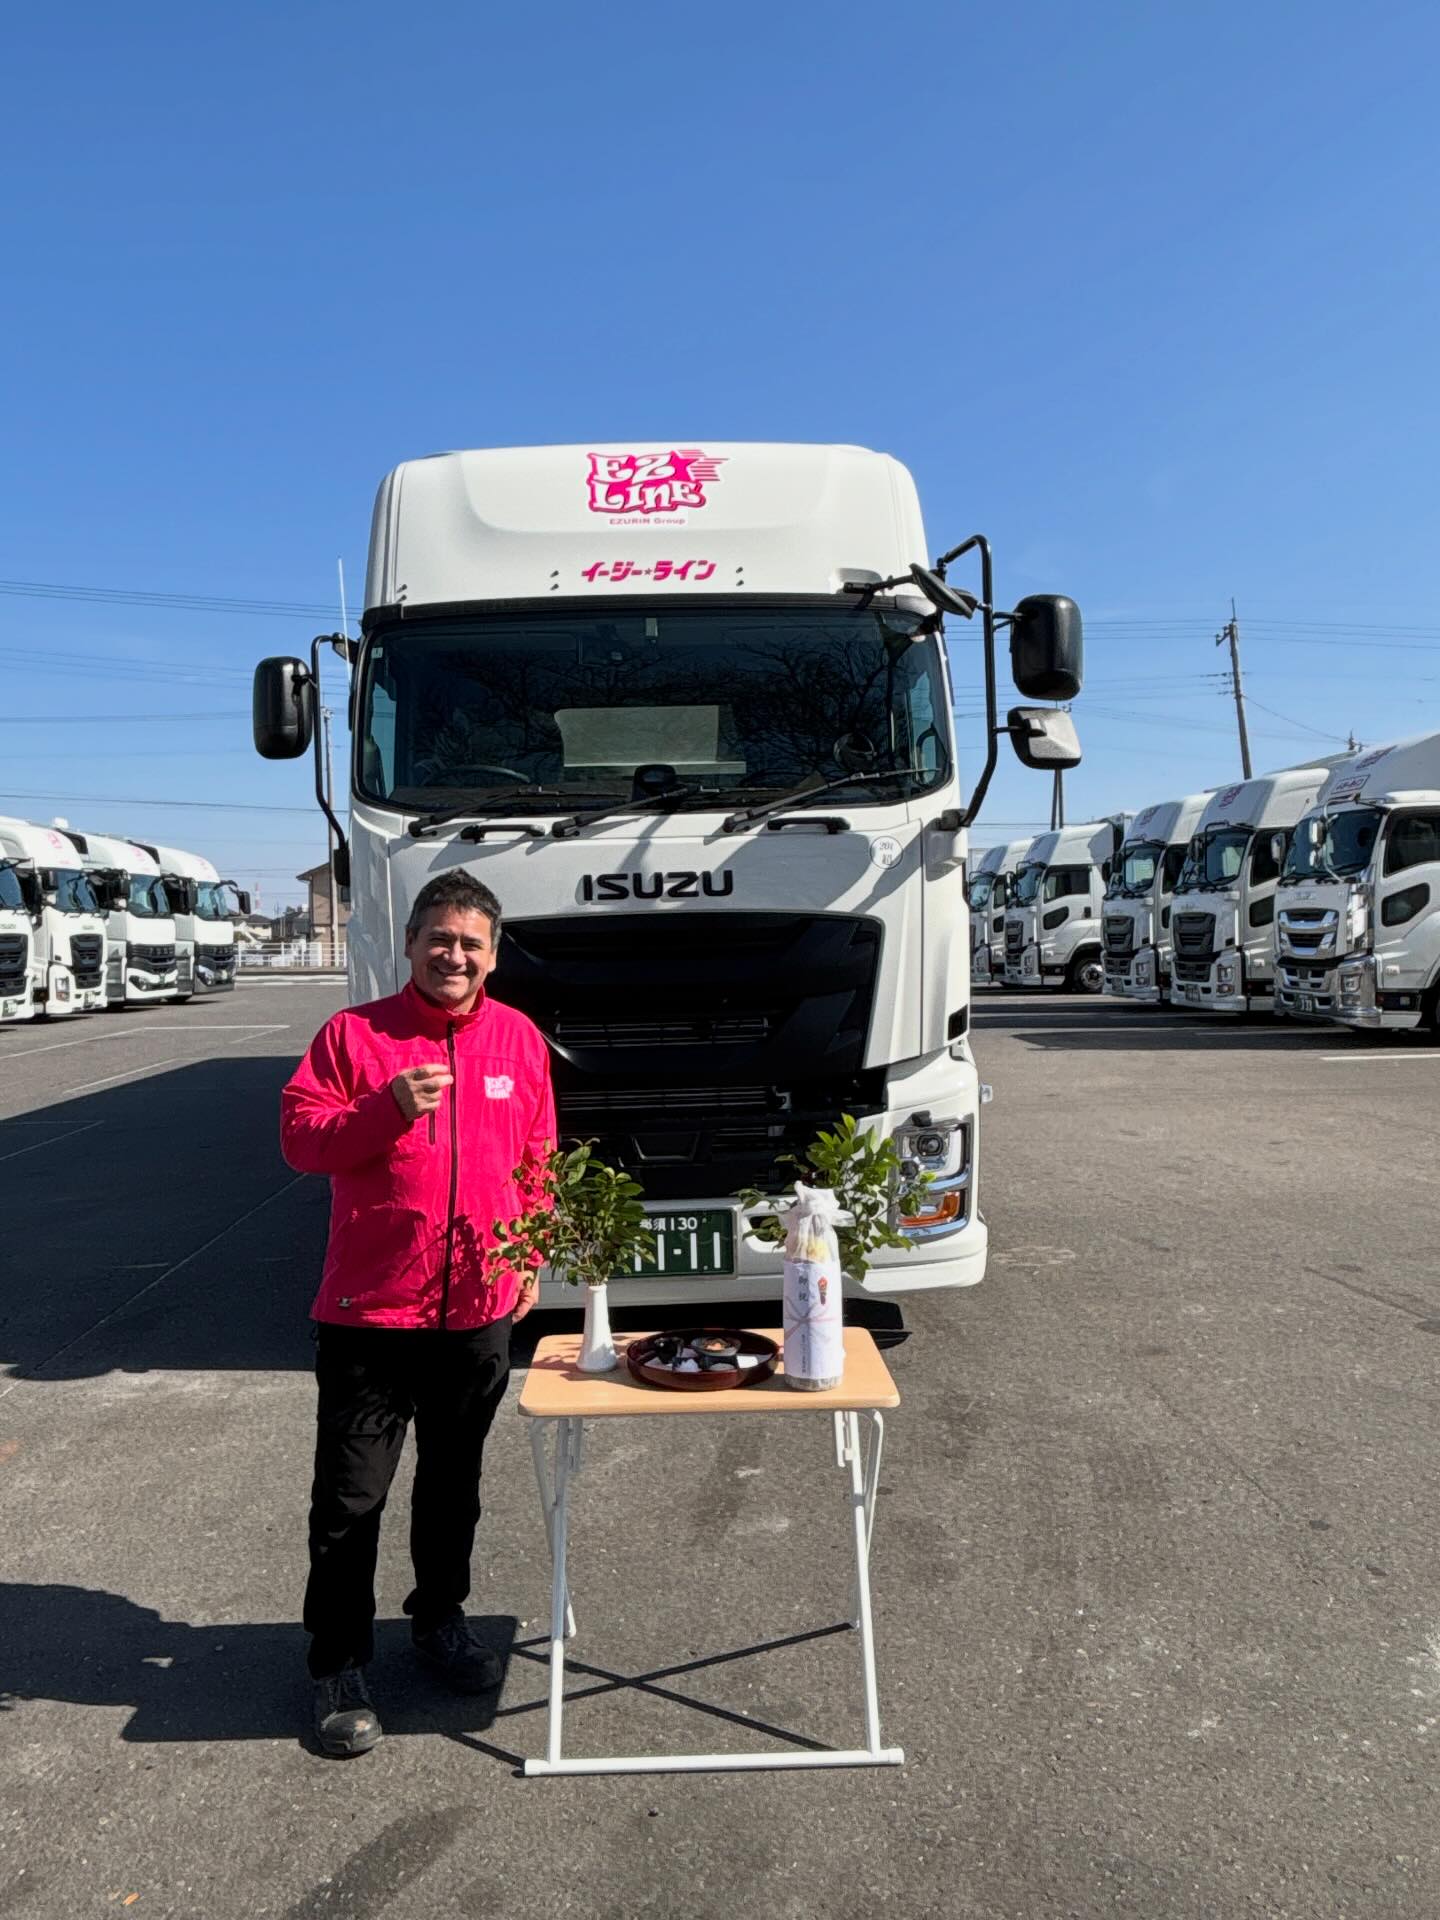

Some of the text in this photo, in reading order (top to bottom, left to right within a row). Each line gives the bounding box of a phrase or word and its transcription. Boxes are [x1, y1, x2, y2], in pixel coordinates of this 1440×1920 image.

[588, 452, 676, 485] EZ
[653, 517, 686, 526] Group
[583, 870, 734, 901] ISUZU
